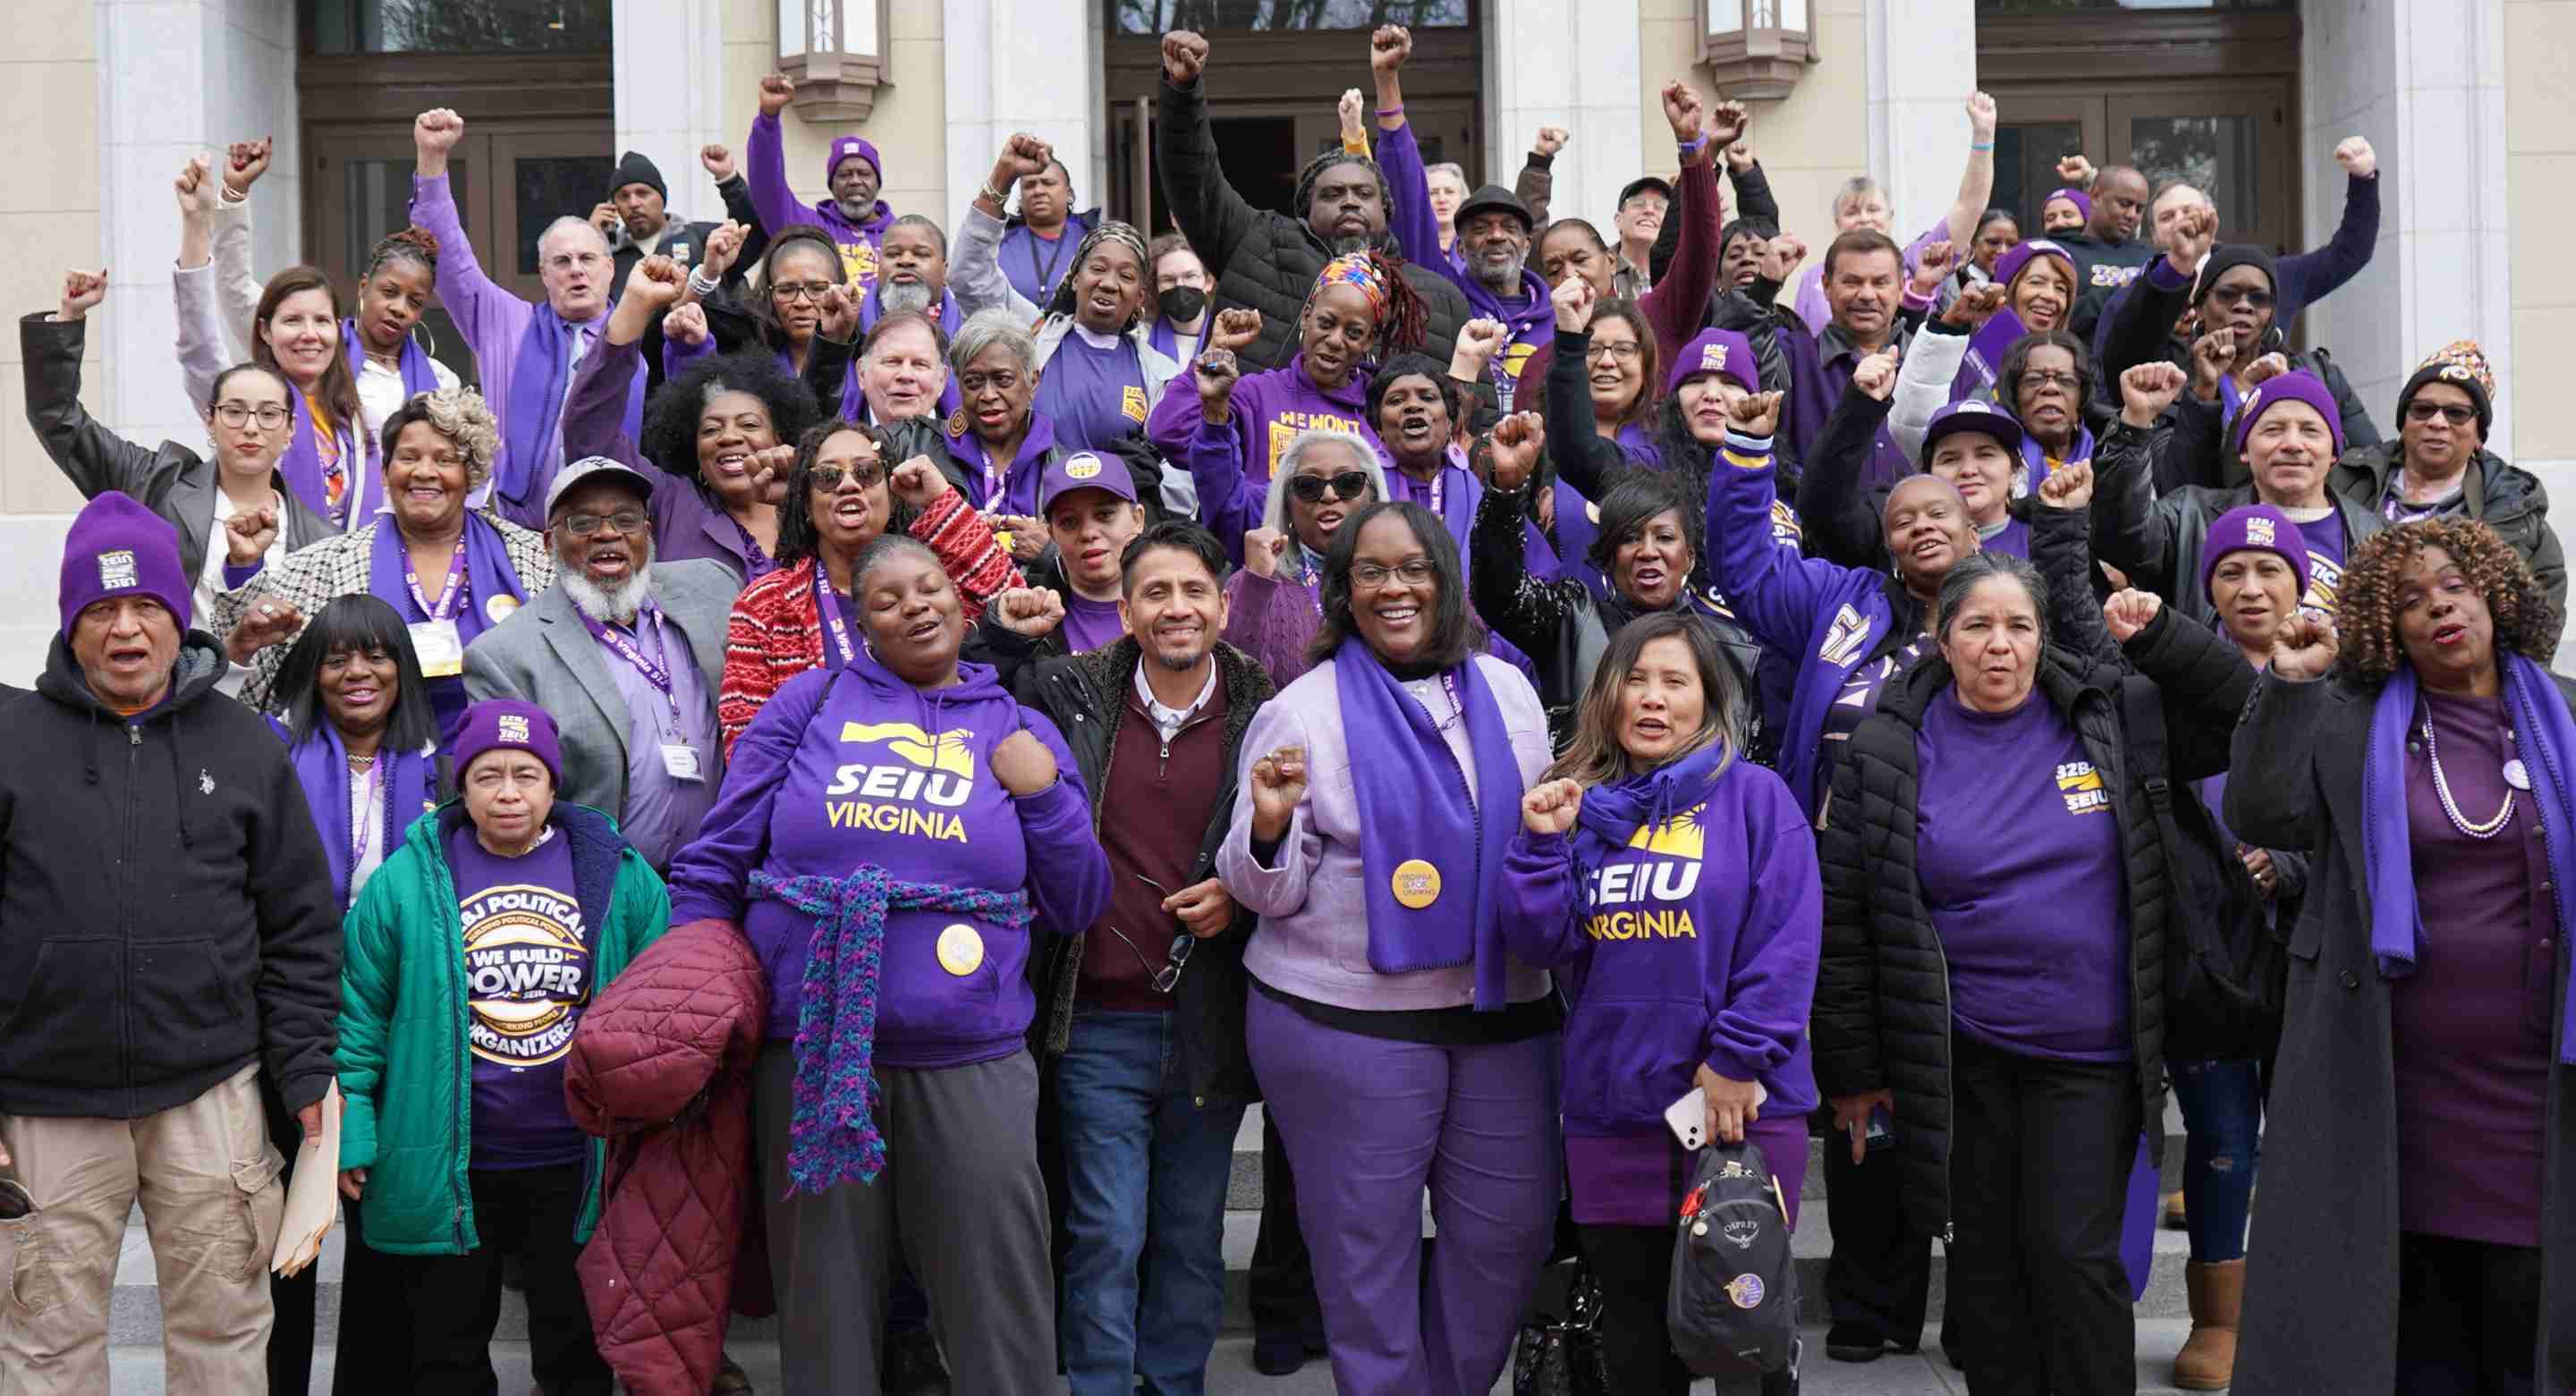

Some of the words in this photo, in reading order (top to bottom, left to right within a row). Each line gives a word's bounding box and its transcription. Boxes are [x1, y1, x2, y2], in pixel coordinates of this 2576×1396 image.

[1280, 411, 1306, 427] WE
[616, 637, 652, 673] Virginia
[826, 764, 973, 807] SEIU
[2055, 761, 2095, 780] 32B
[826, 801, 968, 843] VIRGINIA
[487, 893, 587, 940] POLITICAL
[471, 950, 504, 967] WE
[509, 948, 564, 964] BUILD
